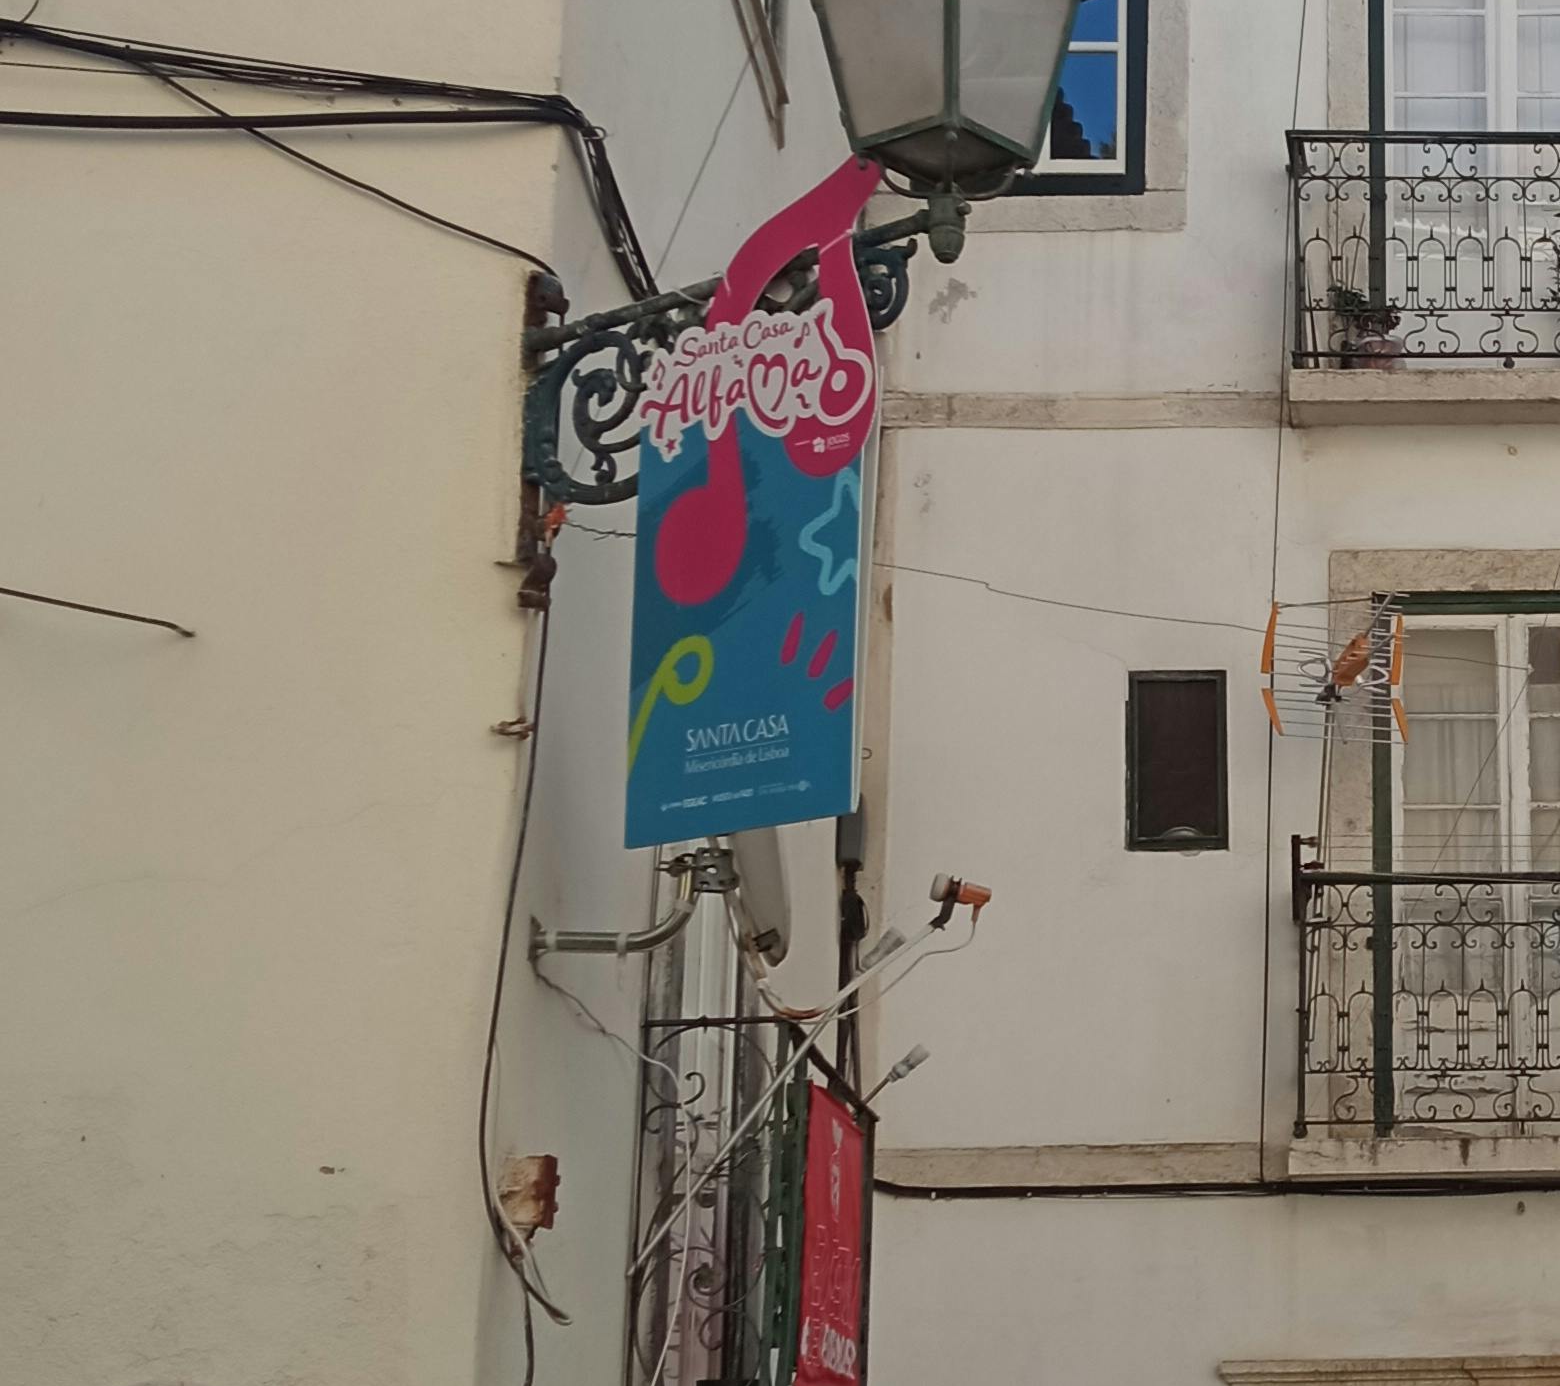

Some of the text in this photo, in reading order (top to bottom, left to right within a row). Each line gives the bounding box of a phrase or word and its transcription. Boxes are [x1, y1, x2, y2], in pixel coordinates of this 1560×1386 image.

[674, 319, 793, 367] Santa Casa
[686, 714, 790, 752] SANTA CASA
